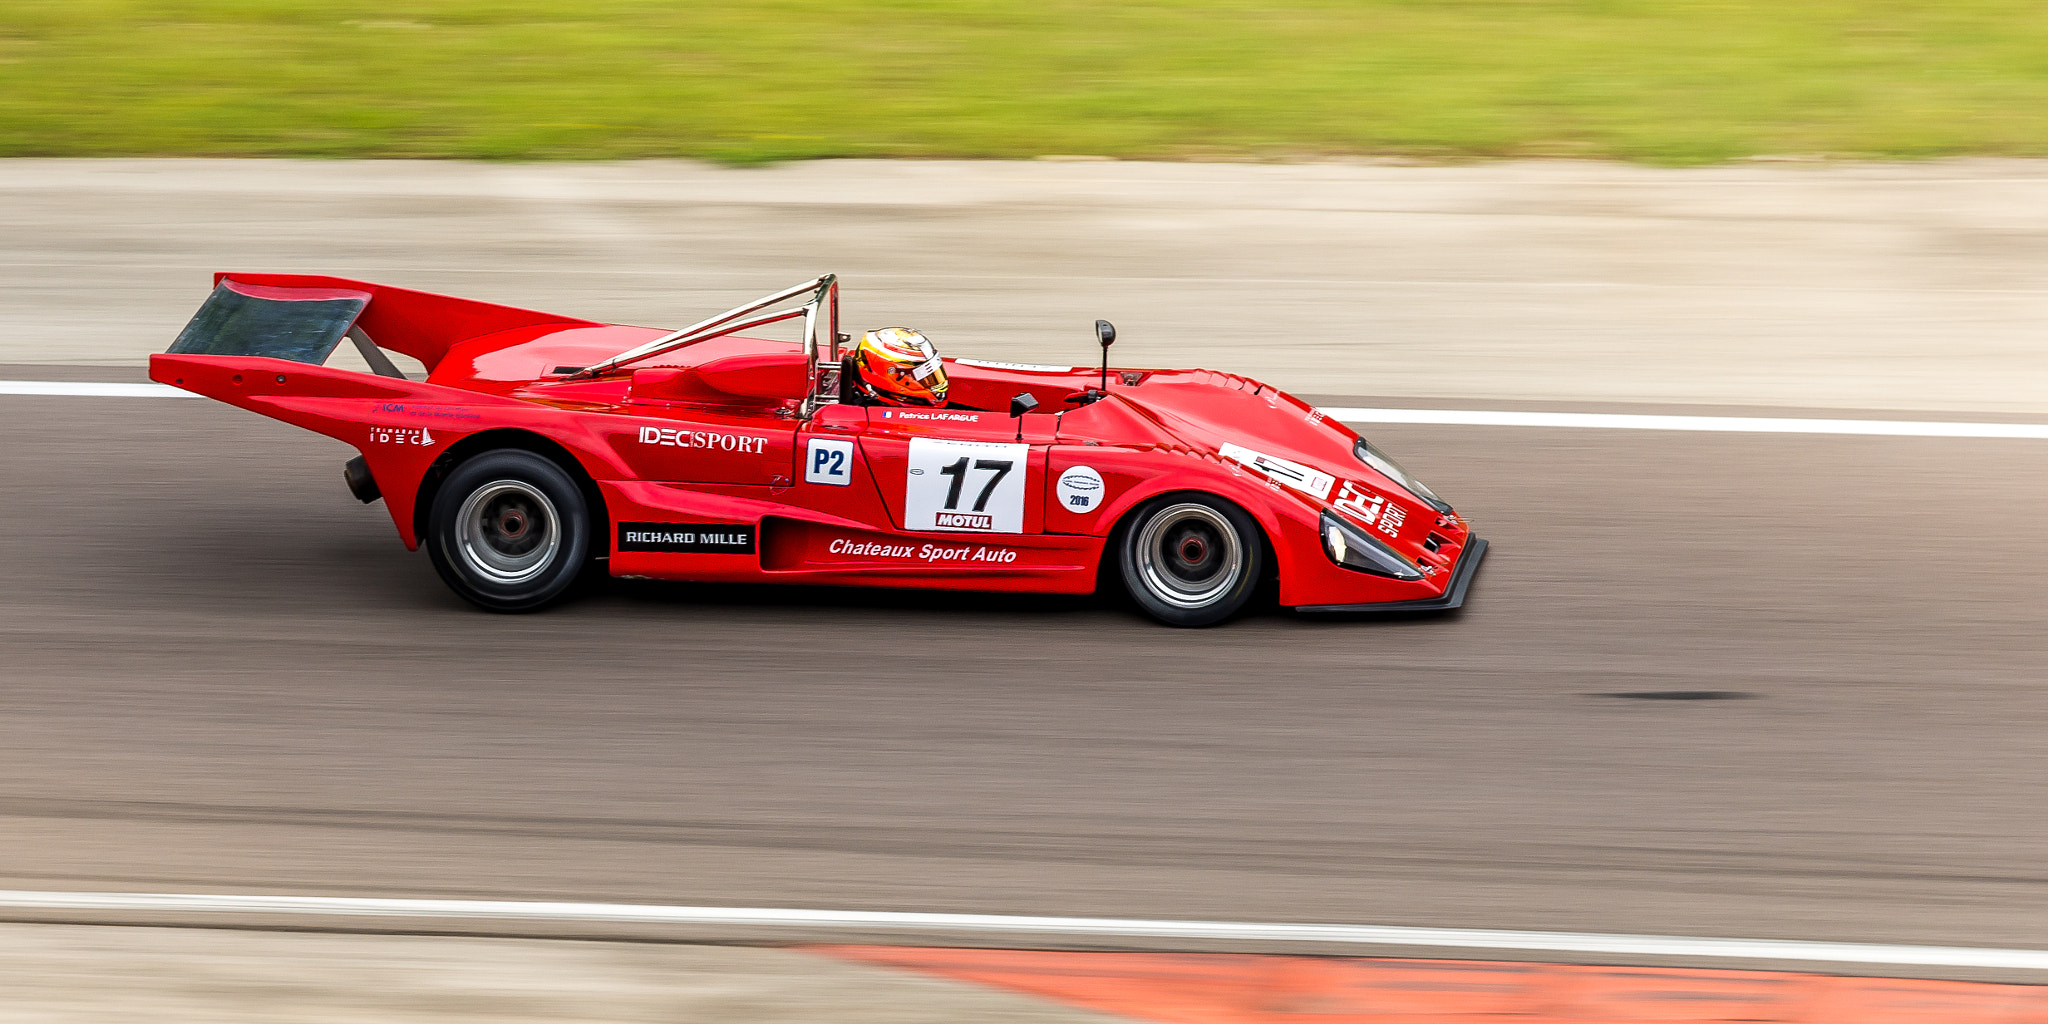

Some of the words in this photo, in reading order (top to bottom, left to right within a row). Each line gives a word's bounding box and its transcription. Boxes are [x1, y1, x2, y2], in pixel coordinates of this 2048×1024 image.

[899, 411, 930, 420] Patrice
[931, 413, 979, 422] LAFARGUE
[369, 433, 420, 445] IDEC
[638, 426, 691, 448] IDEC
[693, 431, 769, 454] SPORT
[813, 448, 844, 476] P2
[940, 456, 1014, 513] 17
[1070, 495, 1090, 507] 2016
[937, 514, 991, 529] MOTUL
[1377, 502, 1409, 539] SPORT
[626, 531, 695, 544] RICHARD
[699, 533, 748, 546] MILLE
[829, 538, 915, 559] Chateaux
[918, 544, 970, 563] Sport
[971, 546, 1017, 563] Auto
